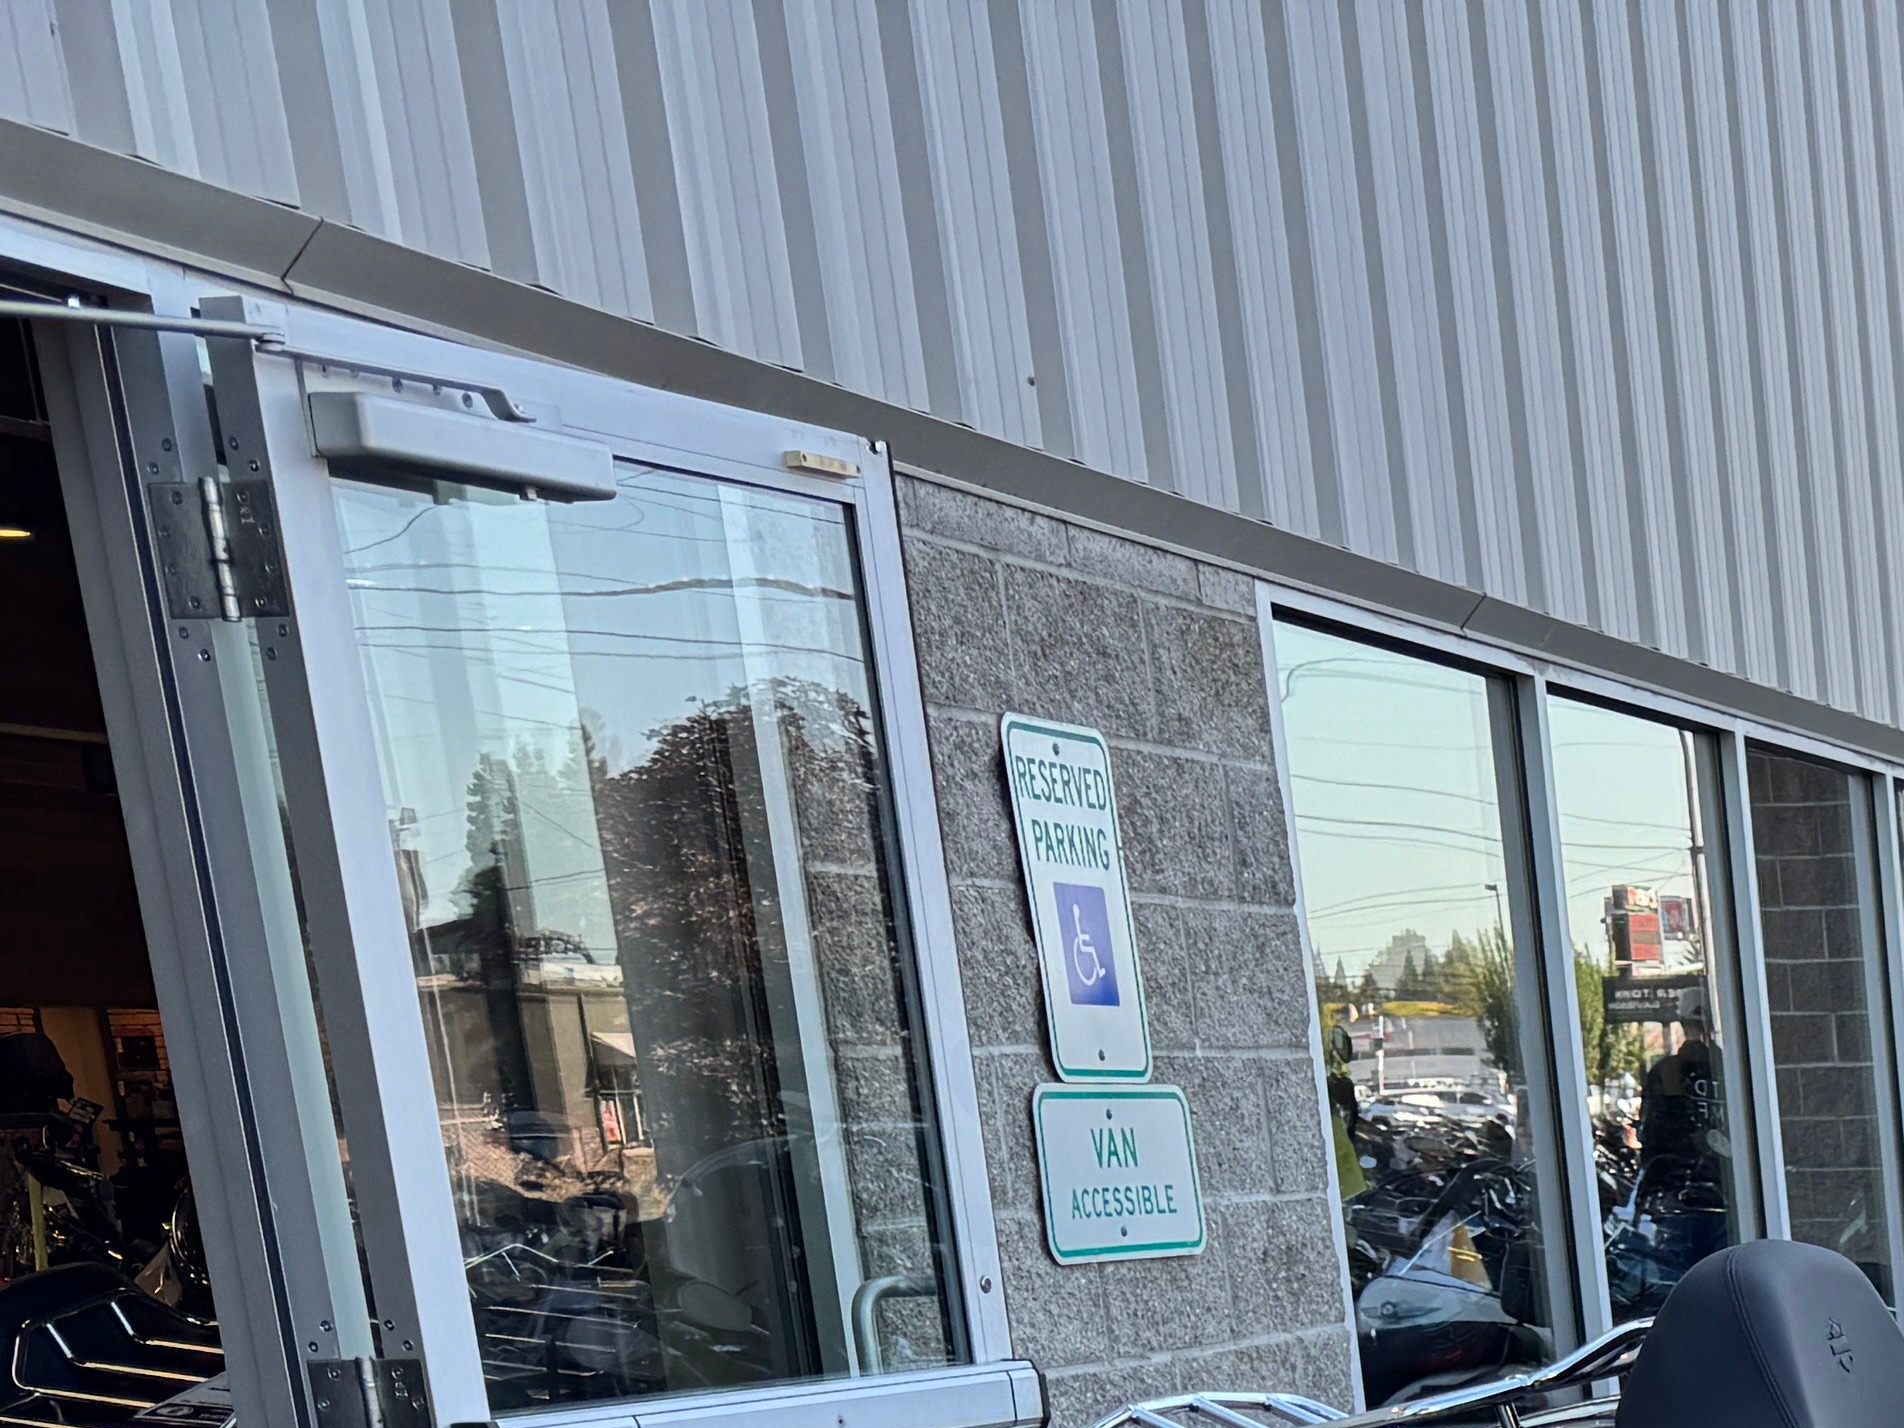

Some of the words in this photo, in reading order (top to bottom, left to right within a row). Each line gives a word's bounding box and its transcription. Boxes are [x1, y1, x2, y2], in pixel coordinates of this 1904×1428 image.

[1015, 755, 1107, 810] RESERVED
[1031, 819, 1110, 871] PARKING
[1090, 1127, 1138, 1169] VAN
[1072, 1184, 1178, 1220] ACCESSIBLE
